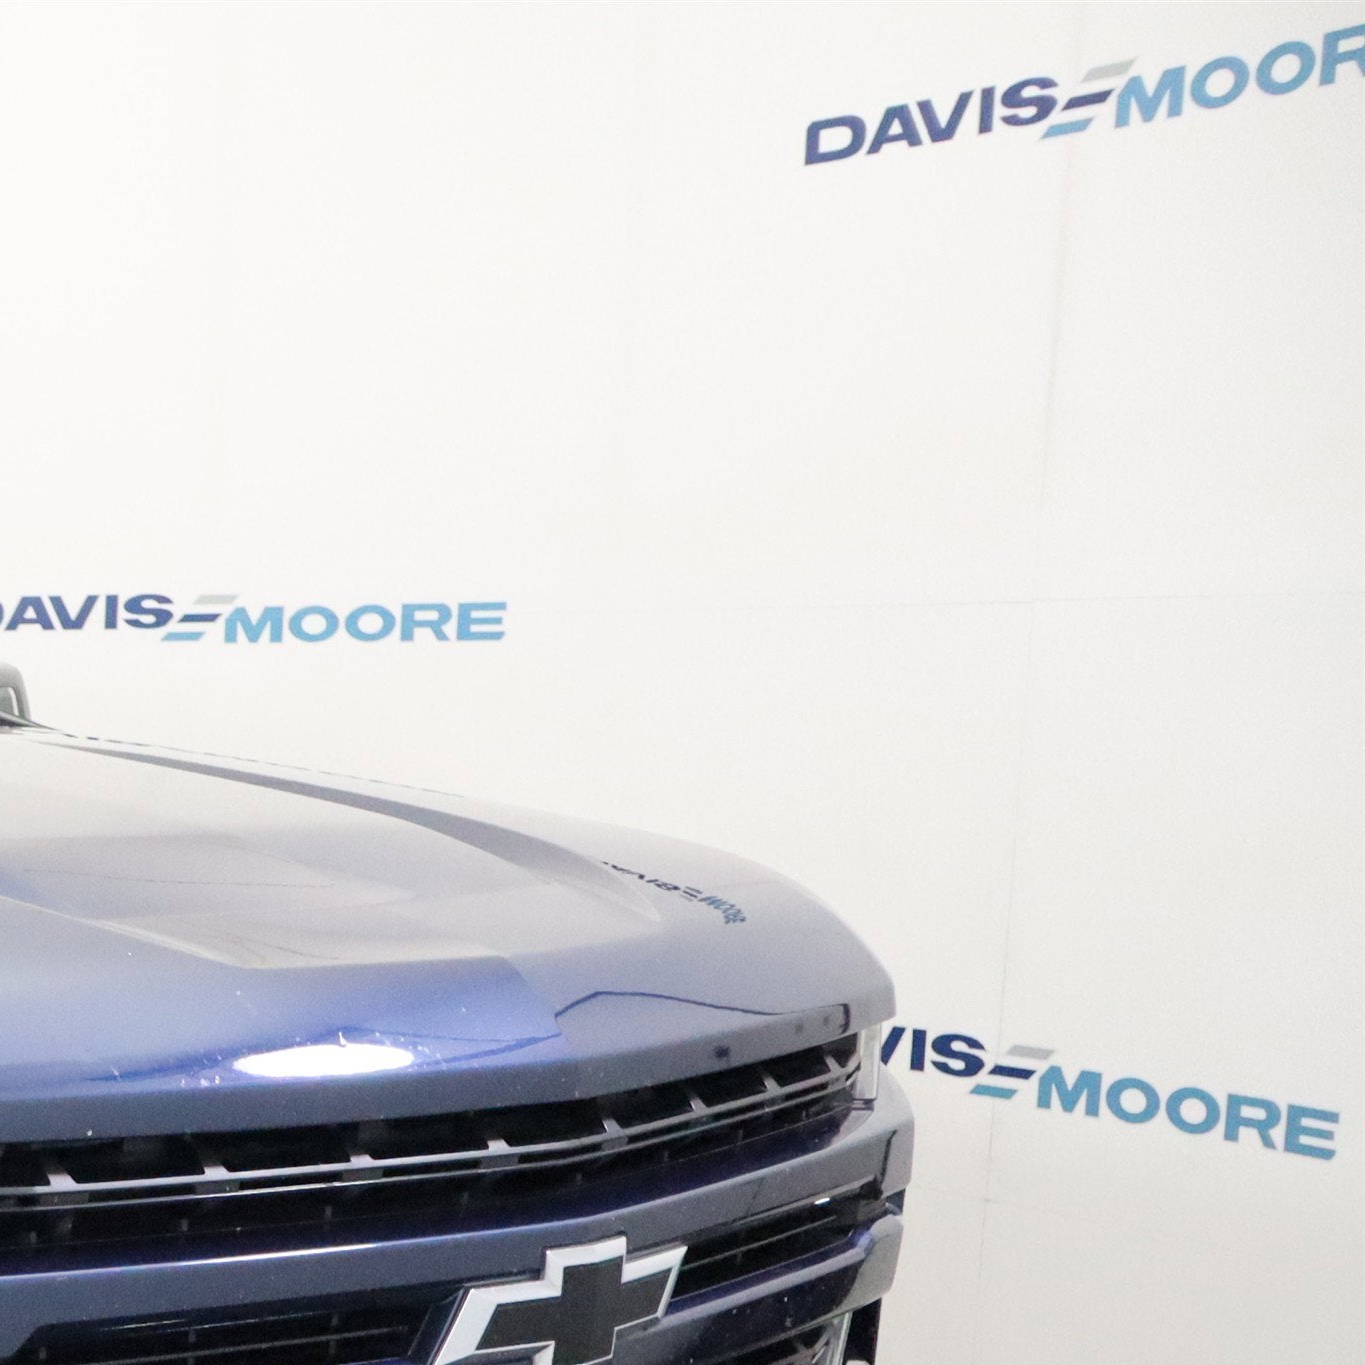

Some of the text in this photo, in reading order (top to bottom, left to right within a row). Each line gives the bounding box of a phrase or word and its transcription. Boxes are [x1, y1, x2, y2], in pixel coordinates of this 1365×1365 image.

[804, 23, 1365, 166] DAVIS MOOR
[223, 601, 508, 644] MOORE
[1036, 1065, 1341, 1161] MOORE
